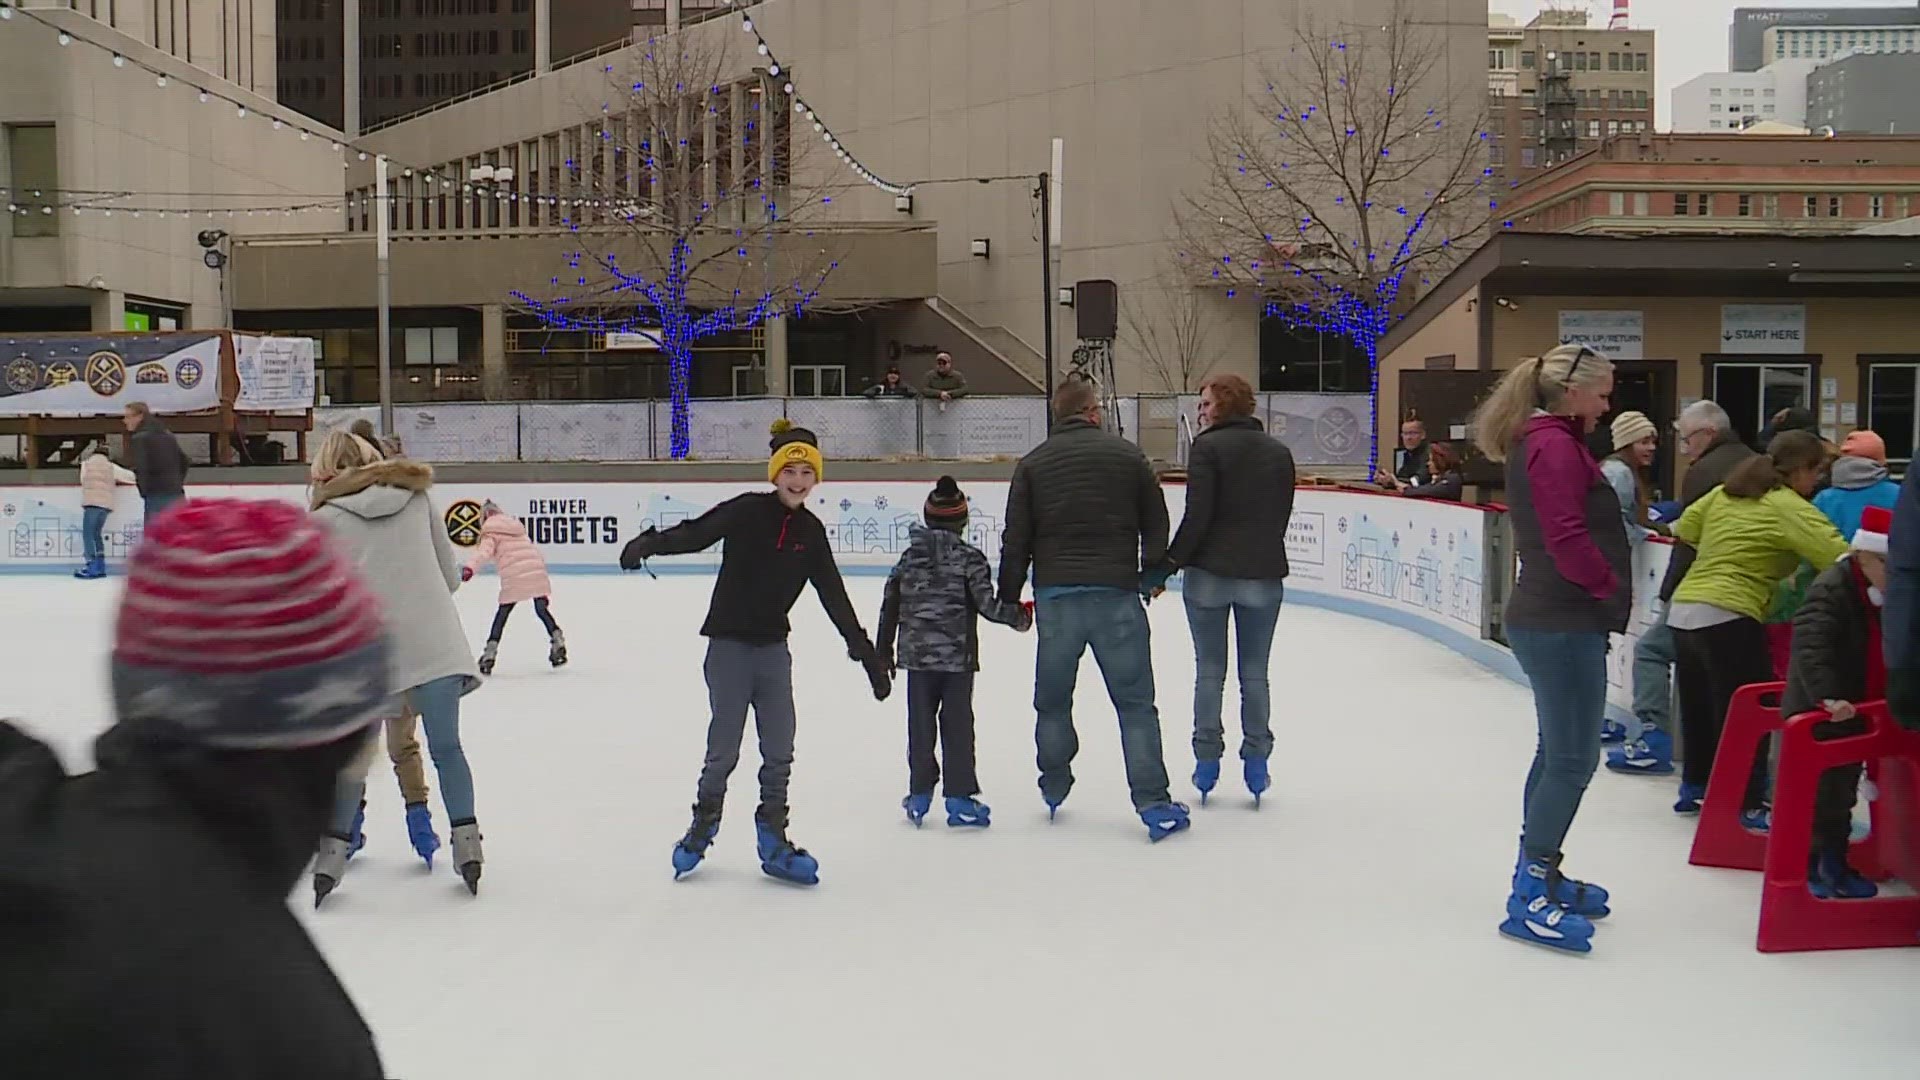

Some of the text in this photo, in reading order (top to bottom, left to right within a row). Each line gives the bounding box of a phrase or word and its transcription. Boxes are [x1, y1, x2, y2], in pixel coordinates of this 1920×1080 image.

[1747, 12, 1780, 21] HYATT
[1735, 329, 1801, 340] START HERE
[529, 499, 587, 514] DENVER
[517, 516, 618, 544] UGGETS
